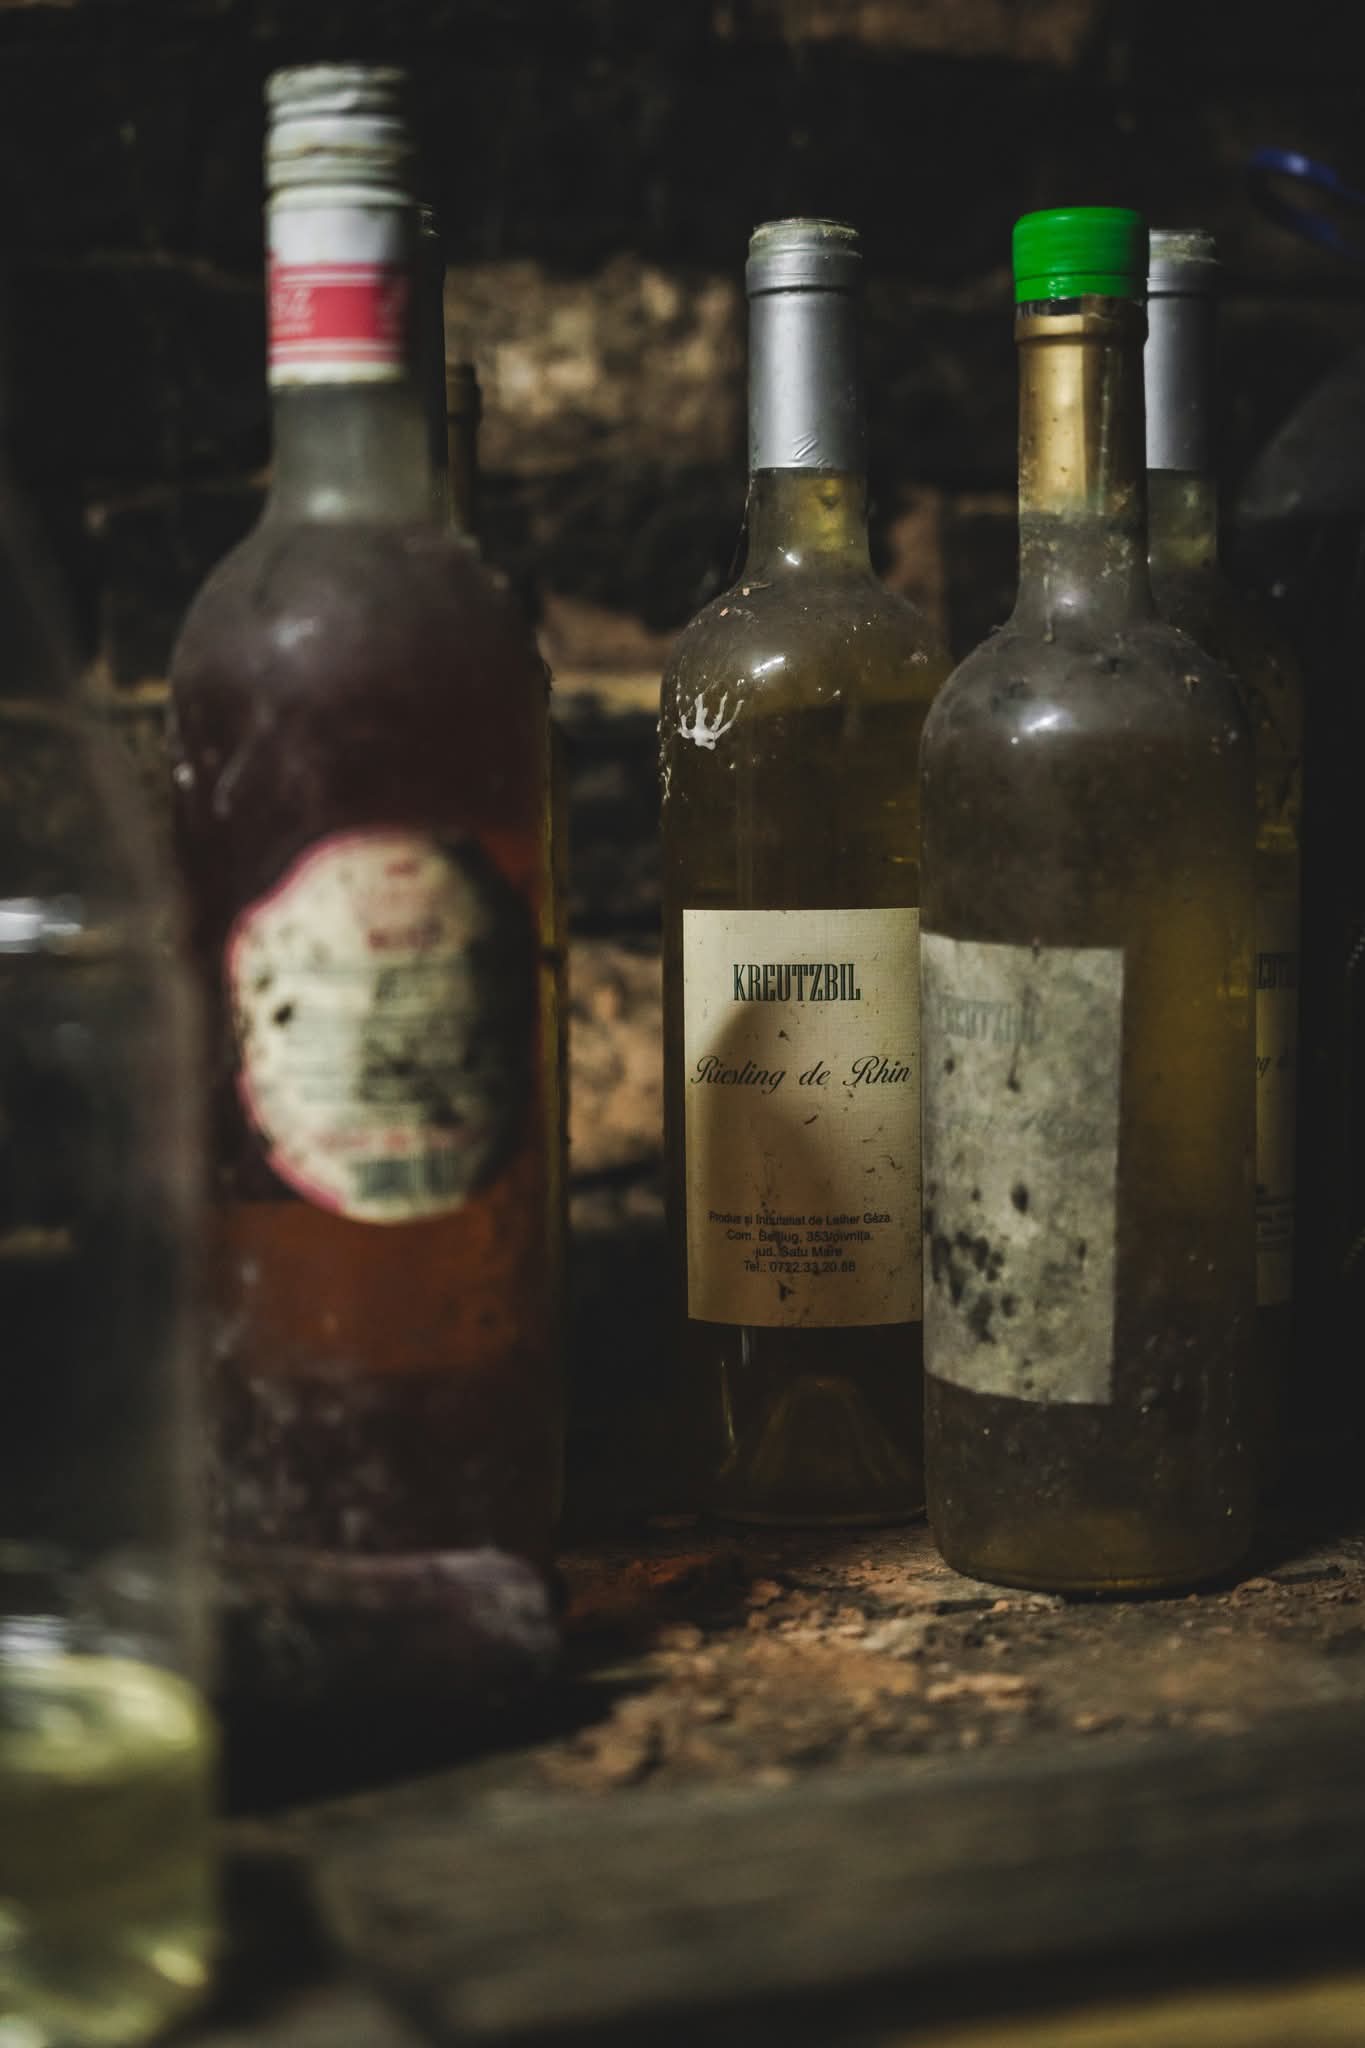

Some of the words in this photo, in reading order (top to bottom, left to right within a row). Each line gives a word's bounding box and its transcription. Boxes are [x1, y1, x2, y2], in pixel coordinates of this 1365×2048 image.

[733, 963, 861, 1001] KREUTZBIL
[690, 1055, 787, 1094] Riesling
[799, 1060, 831, 1086] de
[842, 1055, 912, 1087] Rhin
